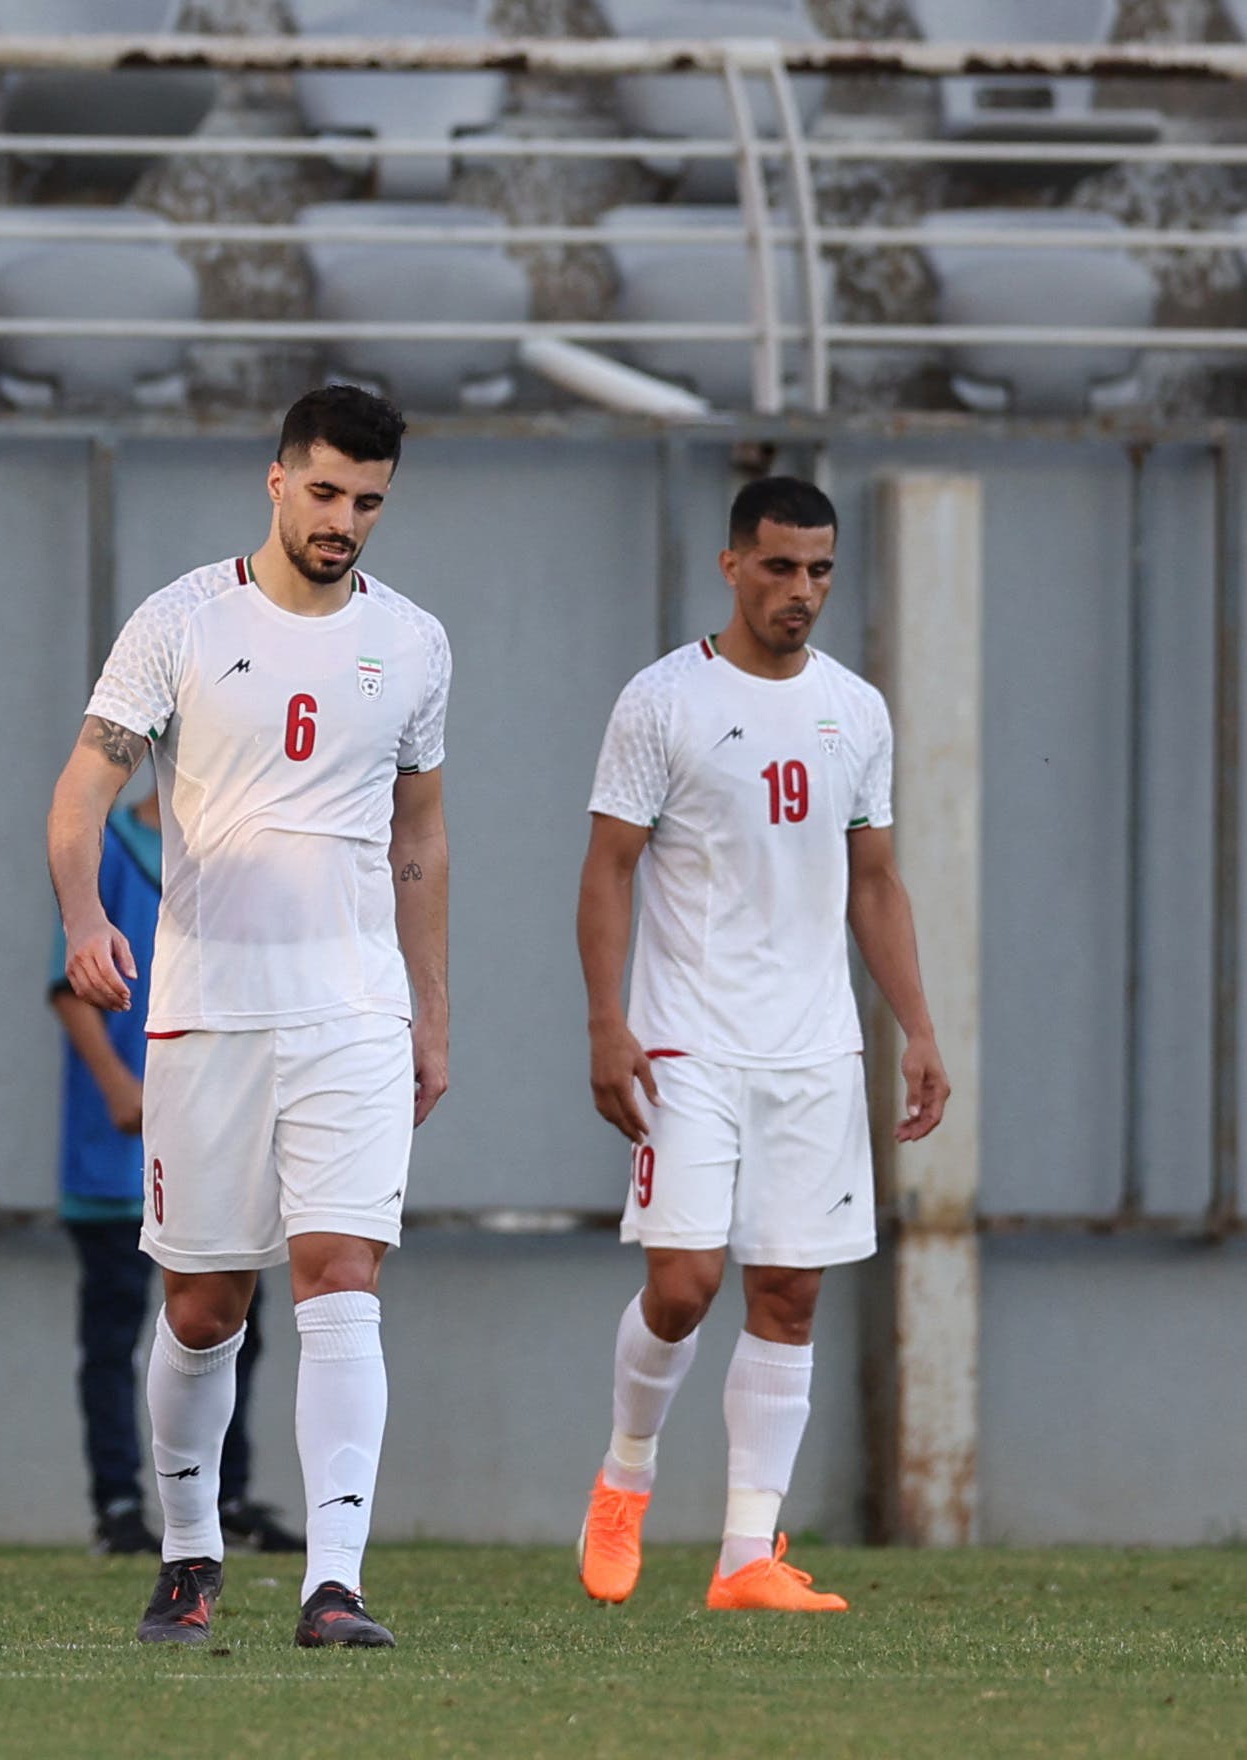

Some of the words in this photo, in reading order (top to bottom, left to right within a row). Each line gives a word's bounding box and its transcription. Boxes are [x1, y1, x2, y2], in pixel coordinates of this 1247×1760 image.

[285, 693, 317, 761] 6
[760, 759, 808, 825] 19
[153, 1158, 163, 1225] 6
